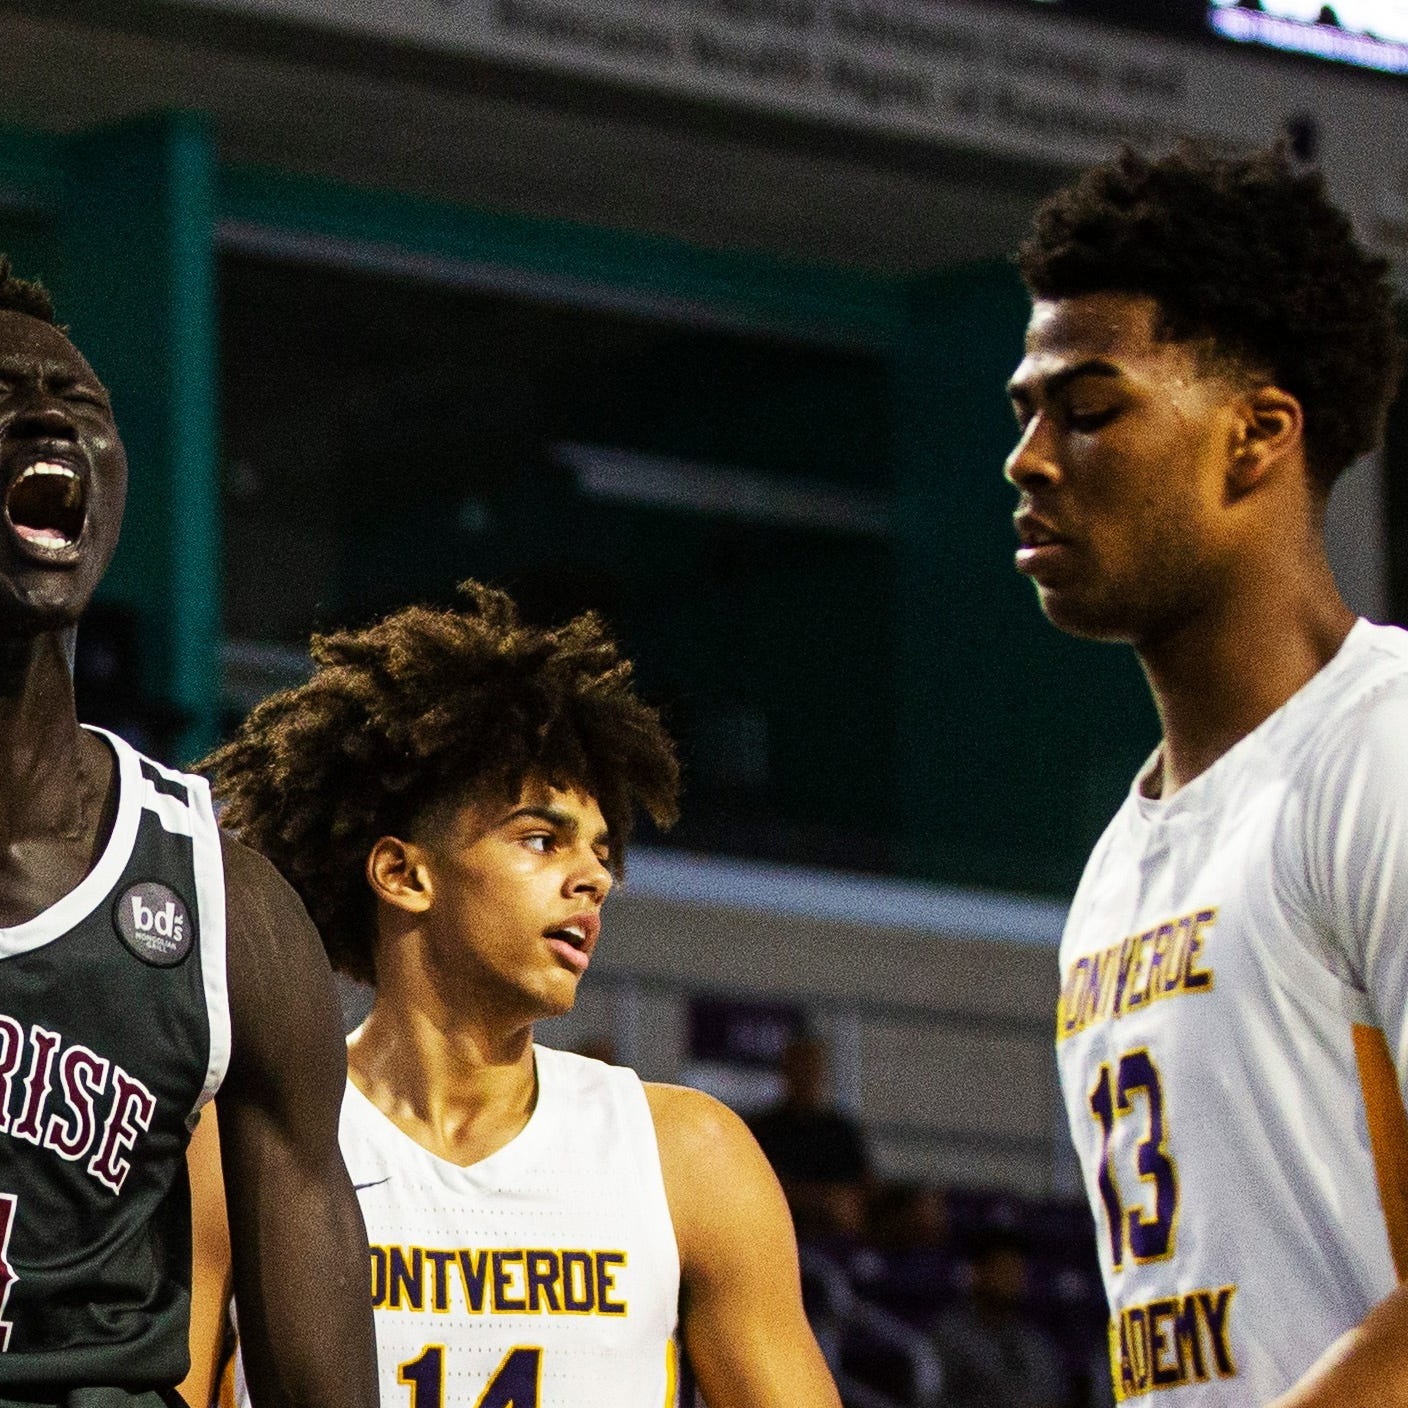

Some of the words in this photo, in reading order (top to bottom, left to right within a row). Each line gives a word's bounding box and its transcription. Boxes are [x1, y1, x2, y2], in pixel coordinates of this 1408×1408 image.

[1058, 907, 1217, 1040] ONTVERDE
[1090, 1046, 1179, 1272] 13
[1109, 1285, 1238, 1401] ADEMY
